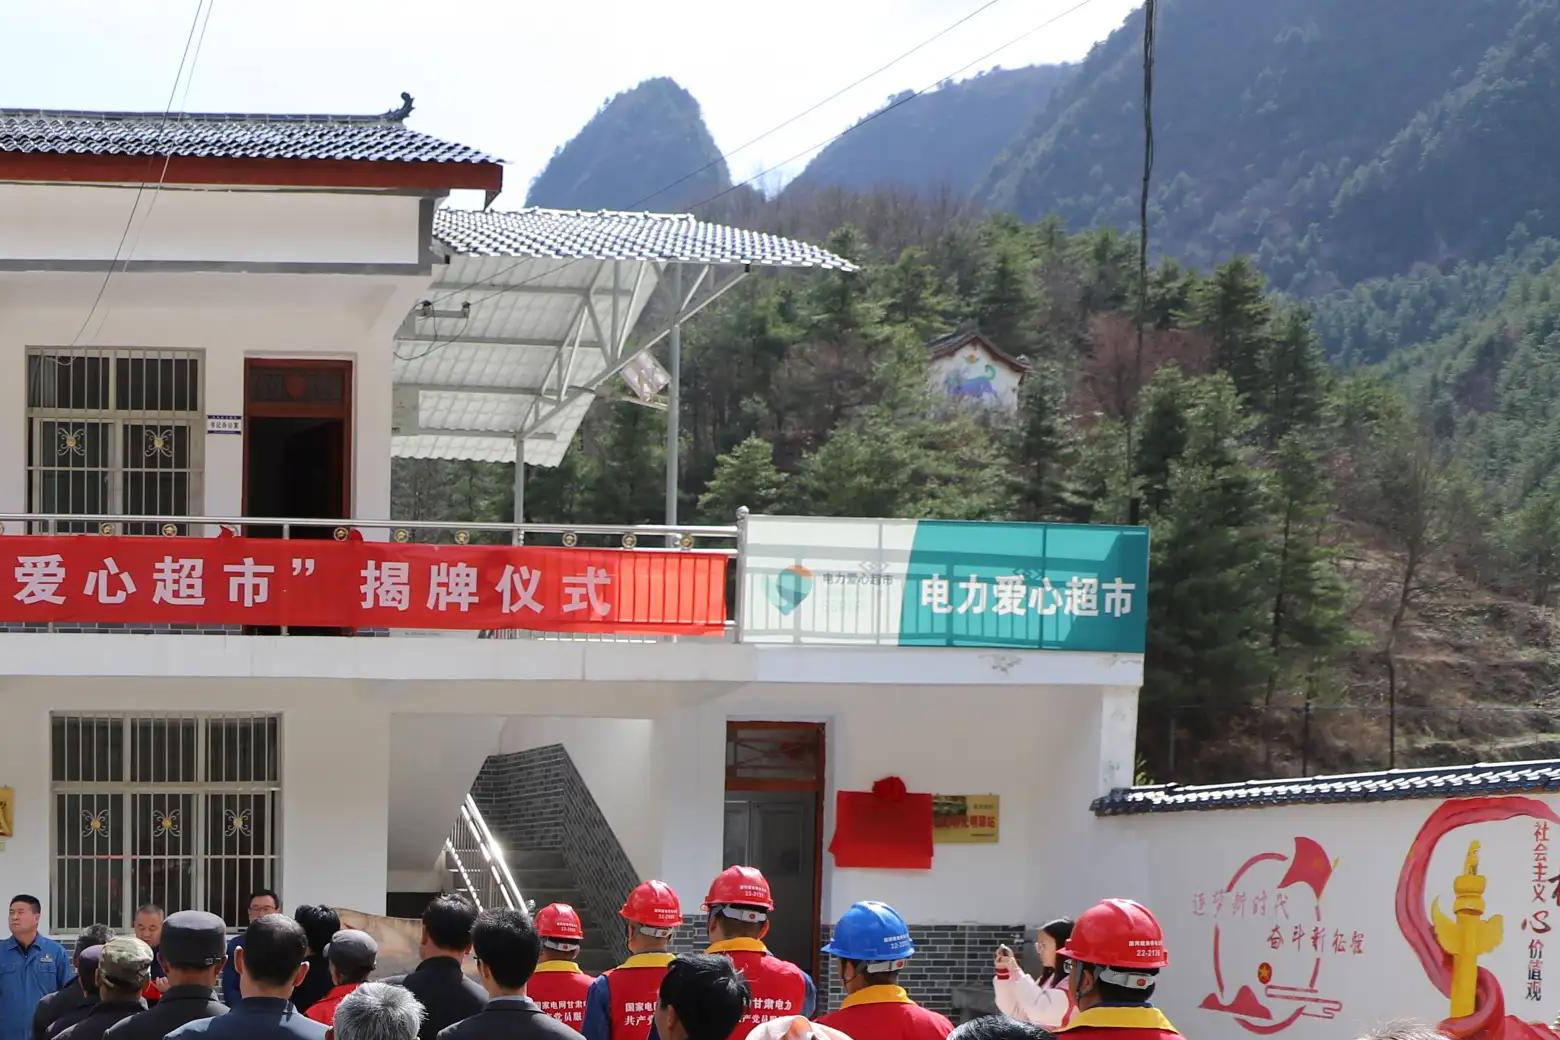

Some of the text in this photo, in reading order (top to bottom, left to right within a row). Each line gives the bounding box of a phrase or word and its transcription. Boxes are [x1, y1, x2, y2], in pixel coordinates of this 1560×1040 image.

[360, 559, 612, 617] 揭牌仪式
[920, 573, 1137, 617] 电力爱心超市
[1525, 938, 1544, 1002] 价值观
[536, 1000, 587, 1011] 家电网甘肃
